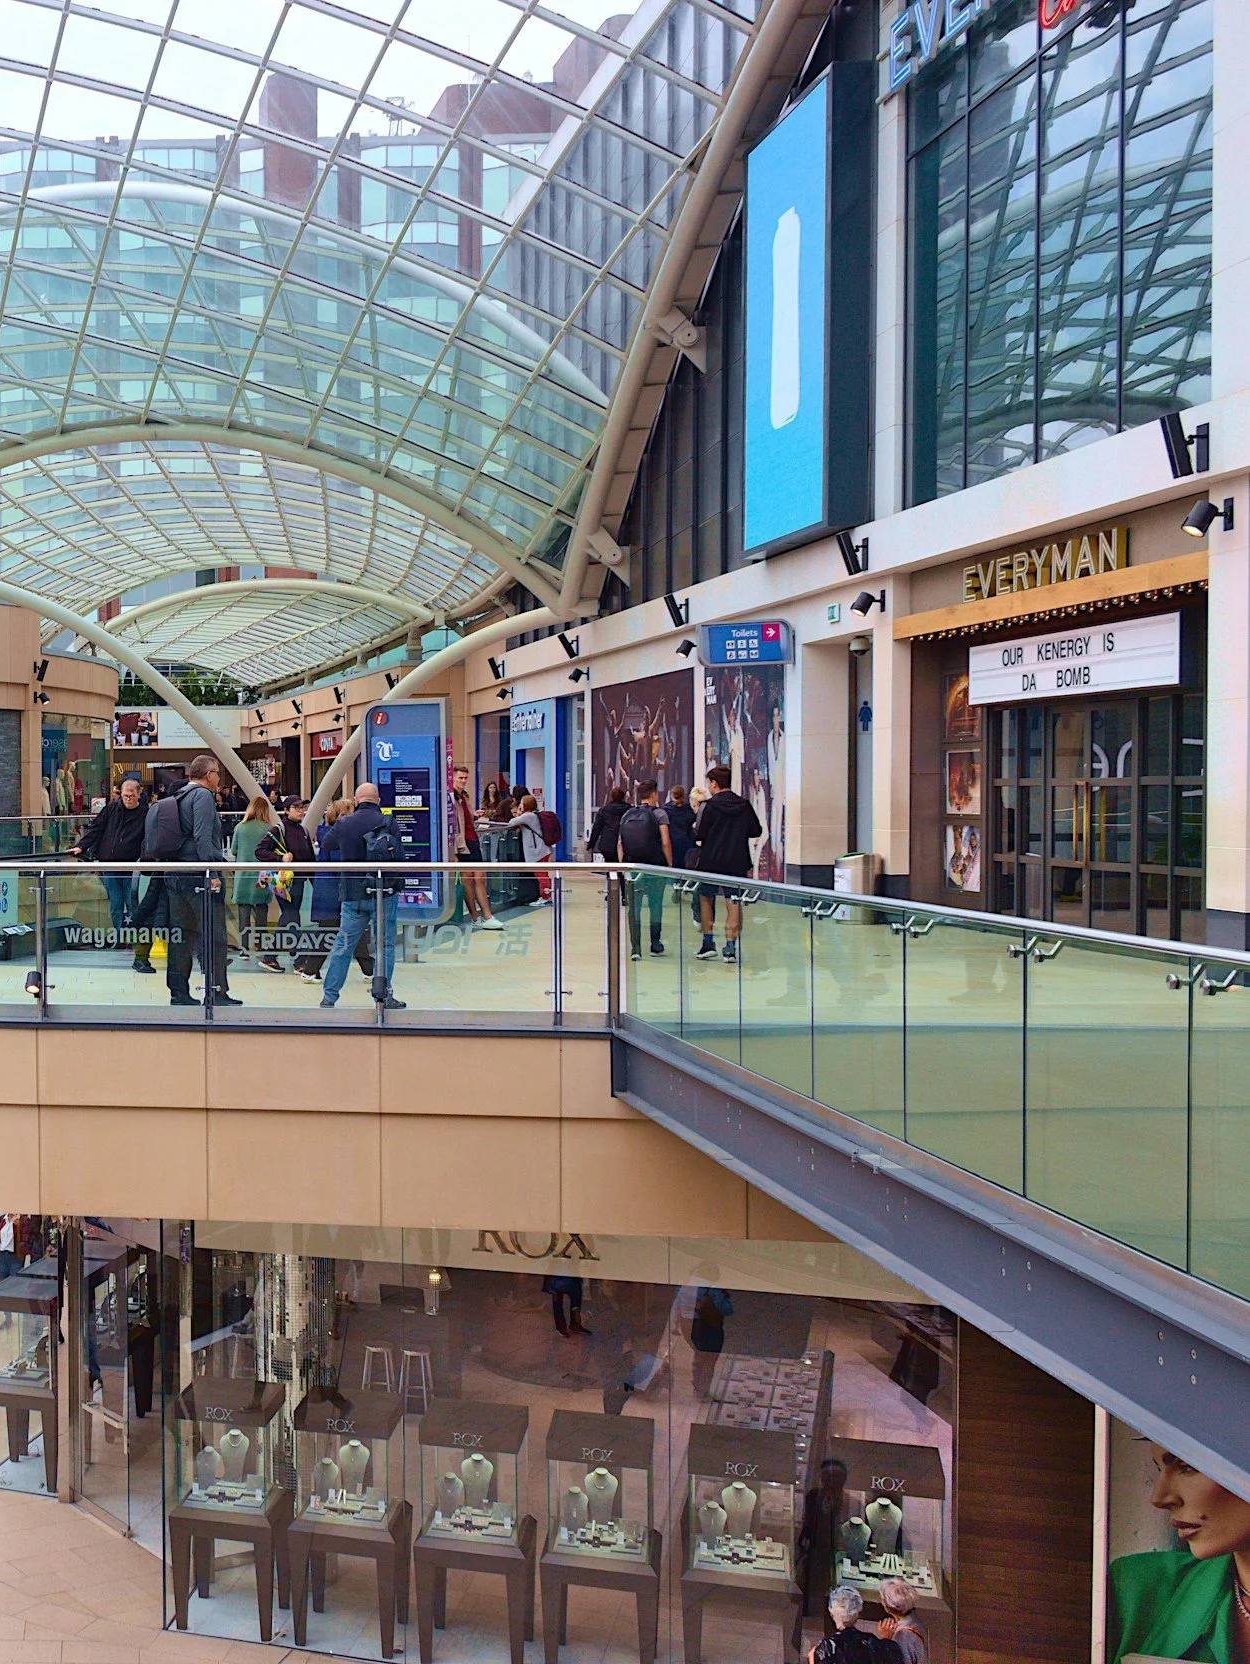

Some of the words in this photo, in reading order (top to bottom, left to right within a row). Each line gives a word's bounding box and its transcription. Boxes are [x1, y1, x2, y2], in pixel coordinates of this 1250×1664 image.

[962, 527, 1120, 603] EVERYMAN
[731, 629, 758, 638] Toilets
[1002, 647, 1023, 667] OUR
[1037, 636, 1091, 662] KENERGY
[1103, 633, 1114, 652] IS
[1022, 673, 1037, 691] DA
[1056, 666, 1091, 688] BOMB
[64, 925, 183, 948] wagamama
[251, 932, 338, 949] FRIDAYS
[205, 1406, 234, 1421] ROX
[326, 1418, 356, 1433] ROX
[452, 1432, 484, 1447] ROX
[582, 1447, 614, 1463] ROX
[725, 1461, 759, 1478] ROX
[870, 1475, 906, 1492] ROX
